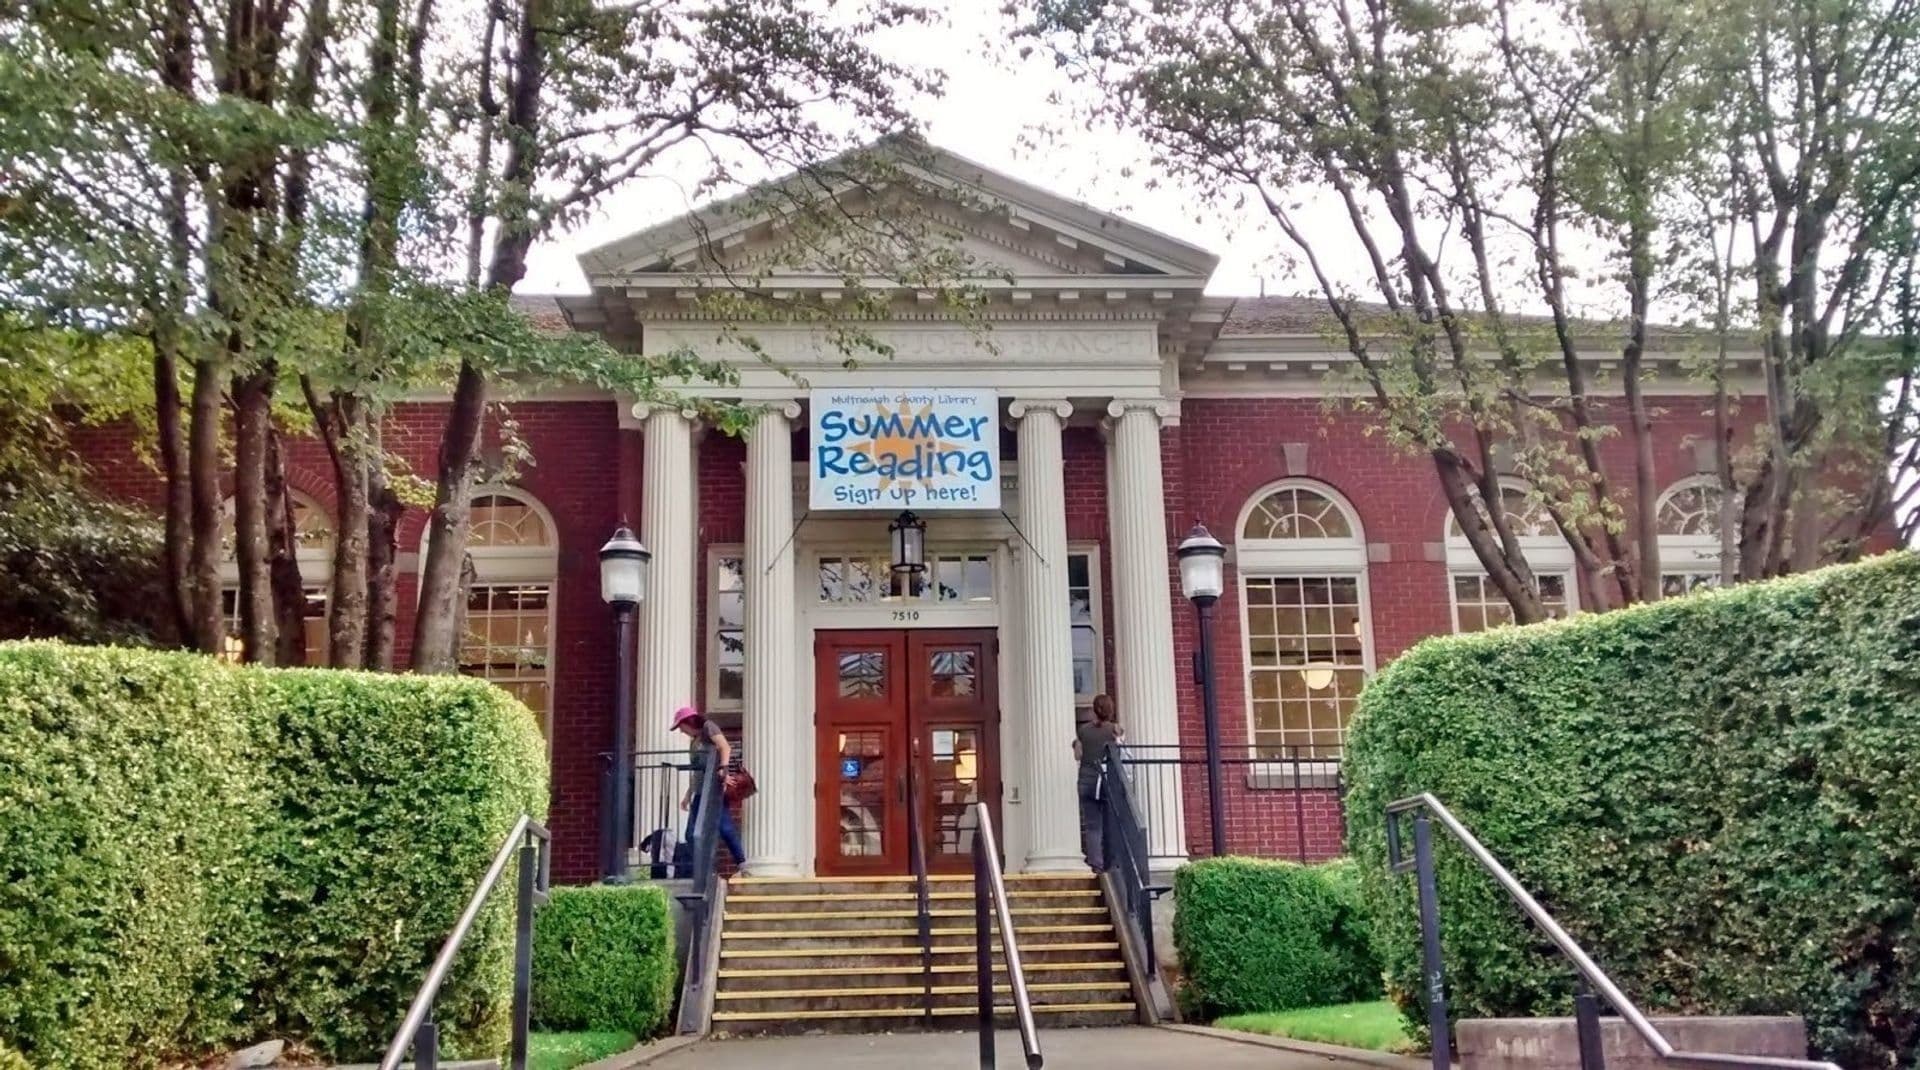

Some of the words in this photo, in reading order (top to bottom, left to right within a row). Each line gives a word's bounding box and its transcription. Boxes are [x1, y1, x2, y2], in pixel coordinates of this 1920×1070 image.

[895, 394, 933, 406] County
[938, 394, 977, 405] Library
[818, 442, 992, 481] Reading
[834, 485, 881, 504] Sign
[890, 487, 916, 505] up
[926, 485, 977, 501] here!
[892, 611, 919, 621] 7510
